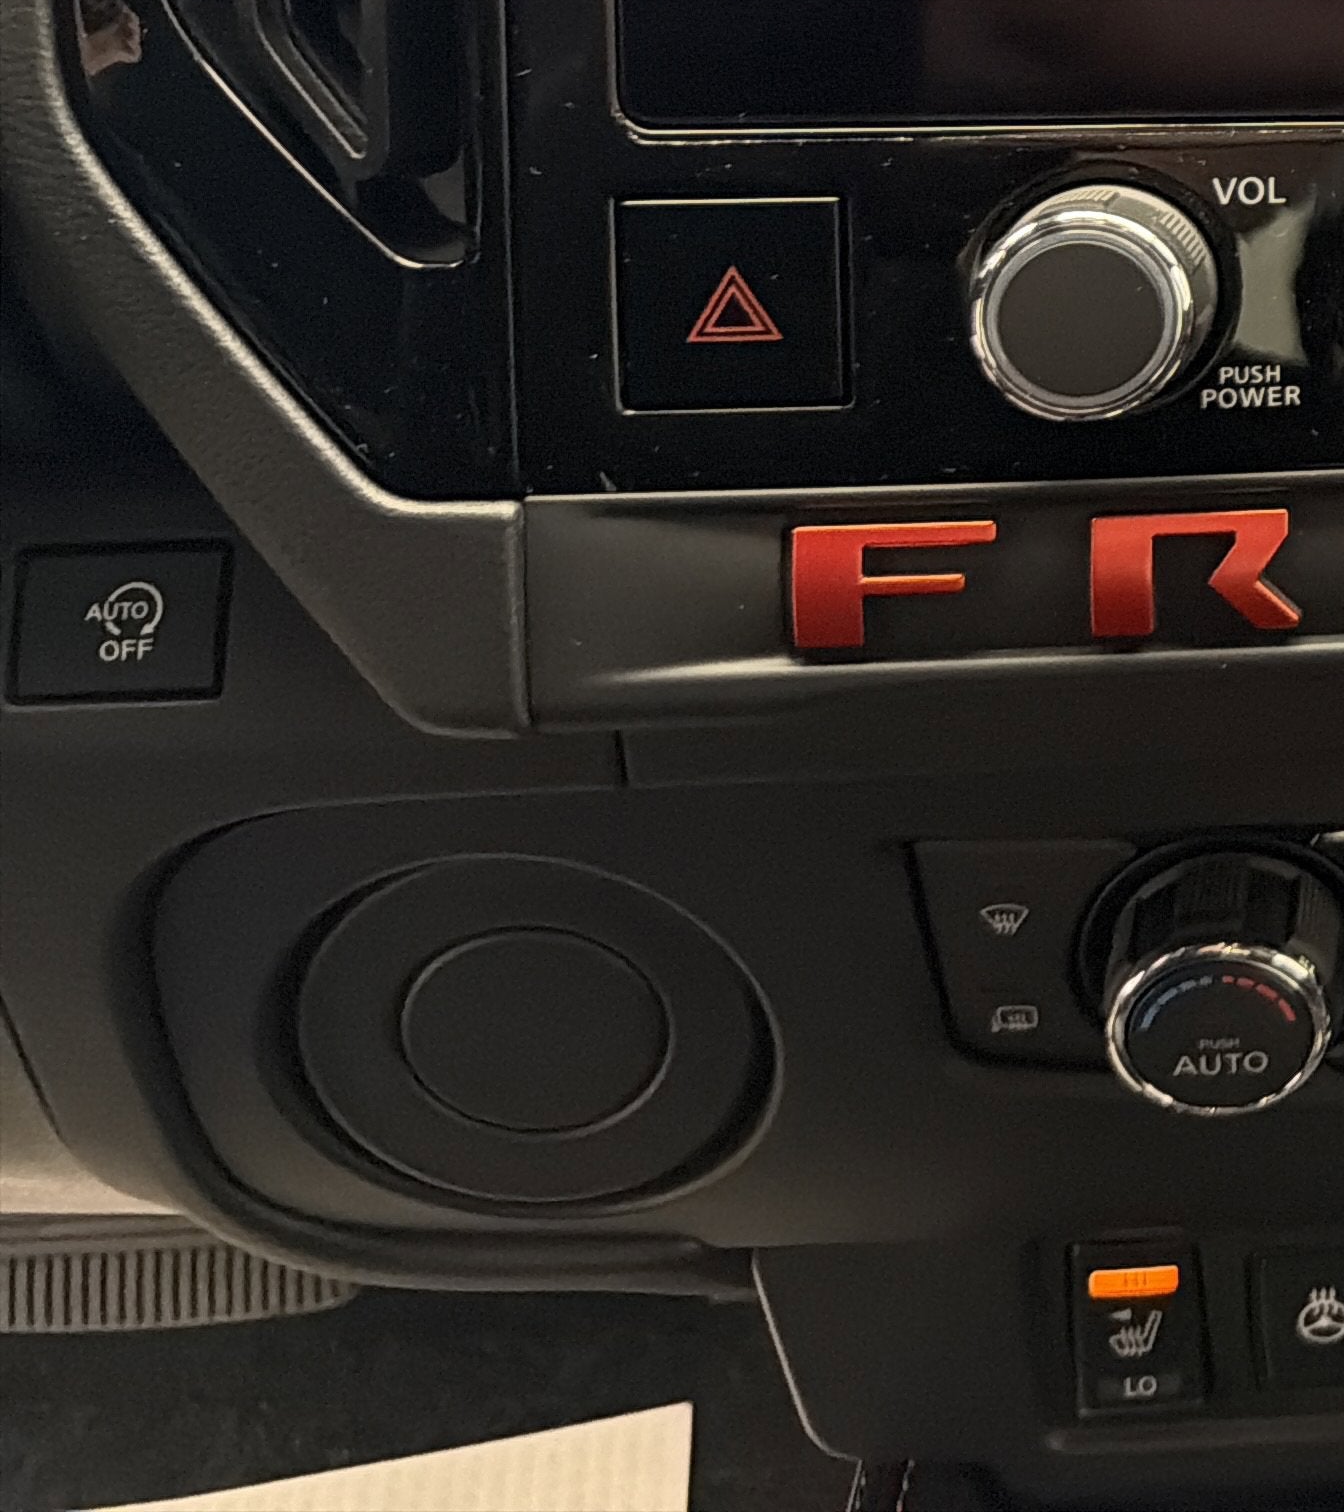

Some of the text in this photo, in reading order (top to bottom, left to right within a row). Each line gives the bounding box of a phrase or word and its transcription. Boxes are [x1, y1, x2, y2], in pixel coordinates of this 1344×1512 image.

[1212, 177, 1287, 206] VOL
[1219, 365, 1281, 385] PUSH
[1200, 385, 1301, 410] POWER
[84, 600, 149, 622] AUTO
[99, 638, 154, 662] OFF
[1172, 1050, 1269, 1076] AUTO
[1123, 1375, 1158, 1399] LO
